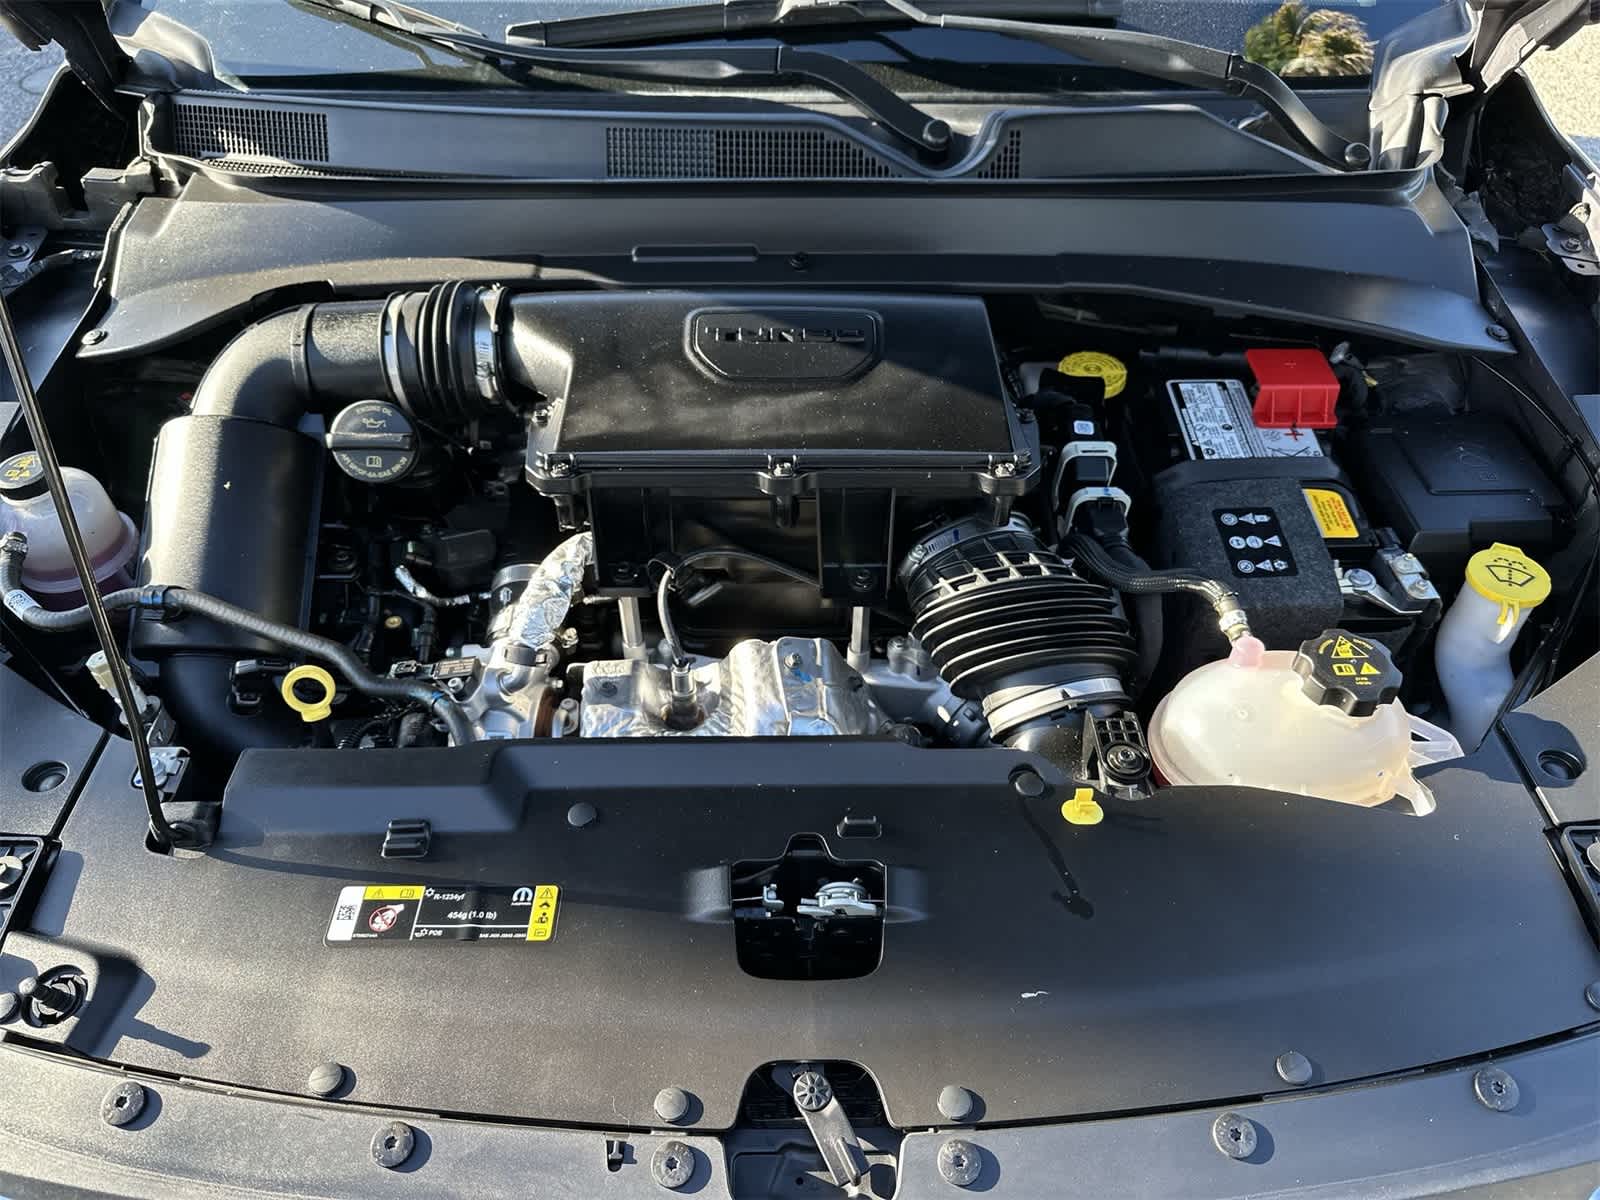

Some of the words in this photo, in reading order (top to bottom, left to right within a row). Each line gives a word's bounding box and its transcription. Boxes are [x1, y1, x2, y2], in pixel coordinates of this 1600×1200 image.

[433, 893, 466, 901] R-1234yf
[447, 911, 467, 920] 454g
[468, 910, 484, 919] (1.0
[485, 911, 497, 920] lb)
